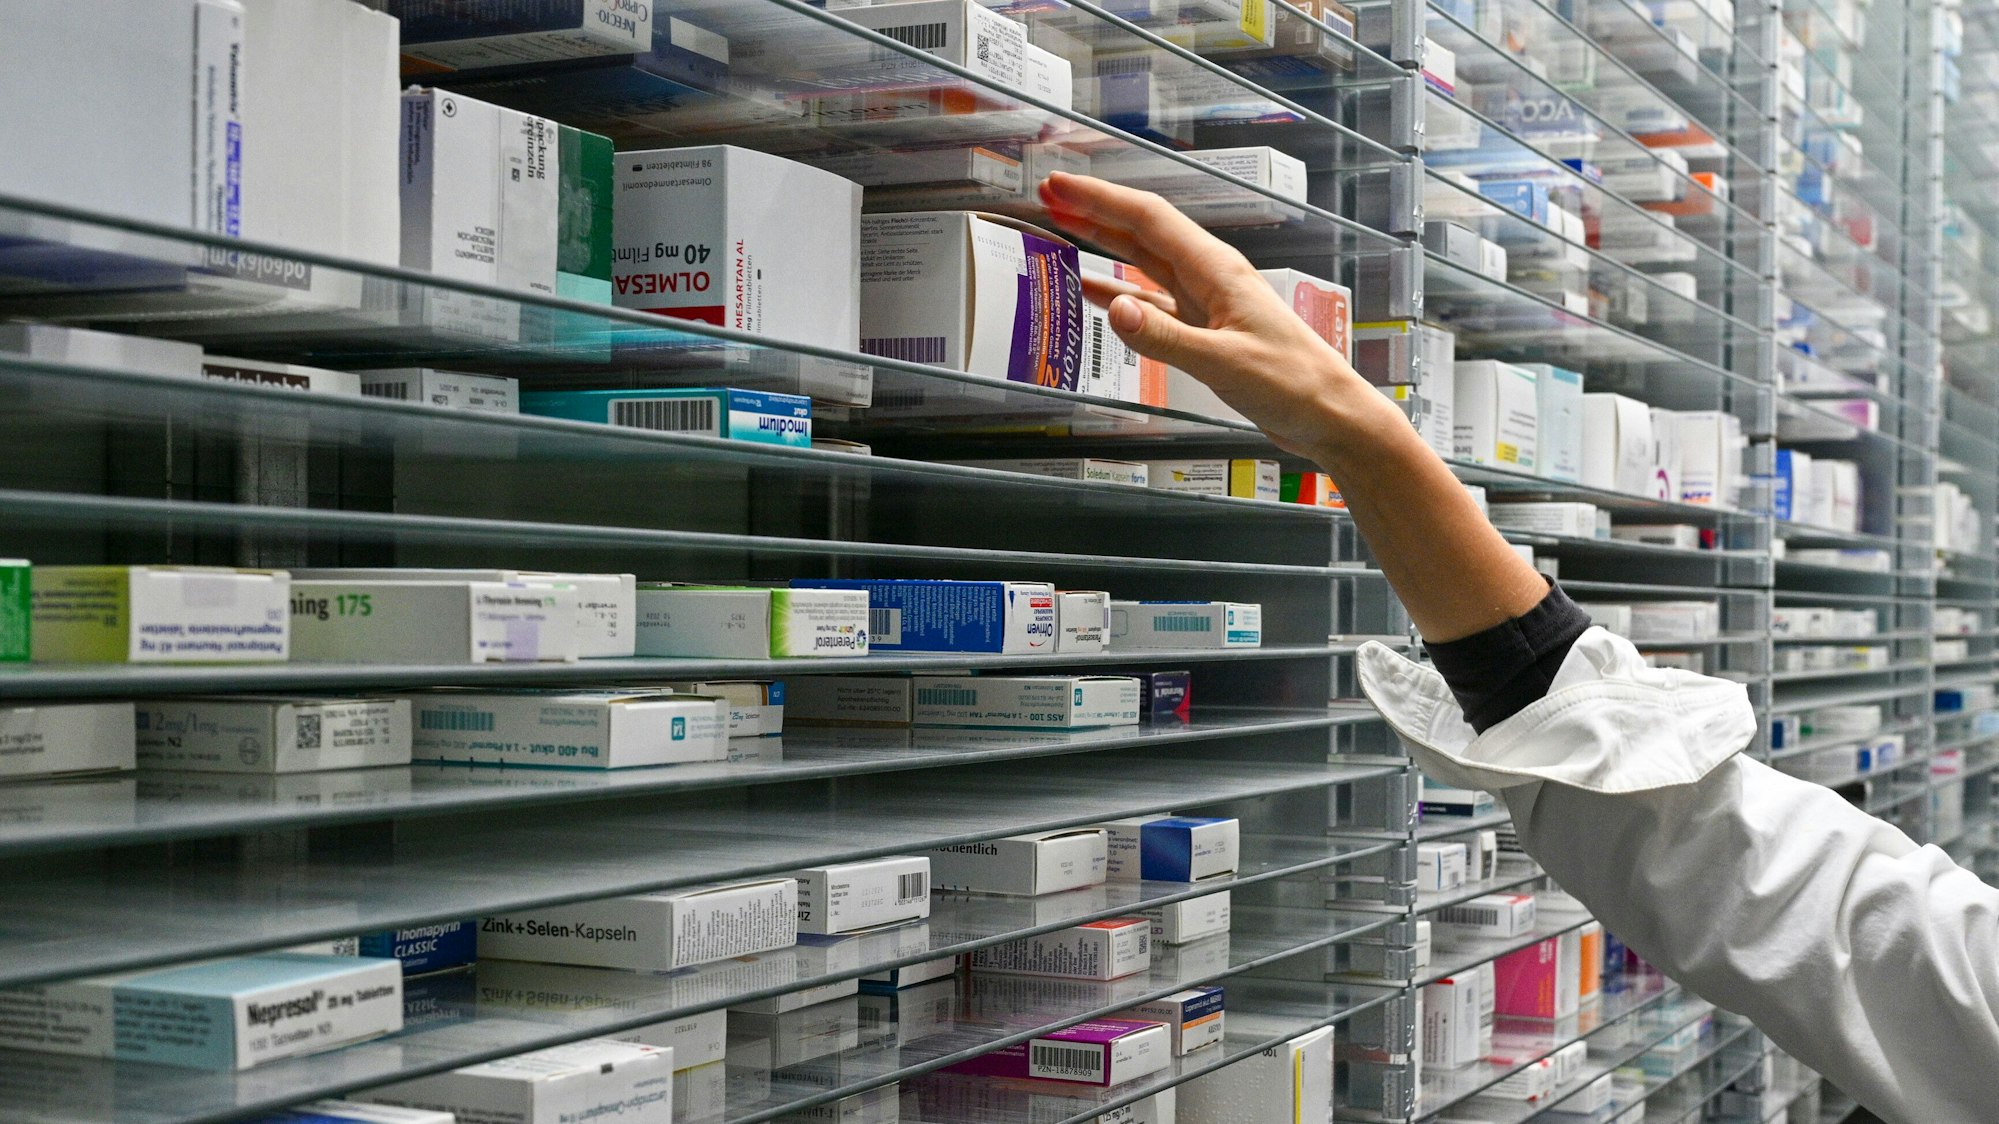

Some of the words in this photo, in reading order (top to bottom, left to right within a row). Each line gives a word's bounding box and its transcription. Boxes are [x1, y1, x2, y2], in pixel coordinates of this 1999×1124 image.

[646, 160, 700, 171] Filmtabletten
[702, 159, 712, 168] 98
[622, 177, 712, 192] Olmesartanmedoxomil
[655, 243, 679, 259] mg
[684, 244, 711, 265] 40
[736, 239, 744, 255] AL
[612, 247, 650, 264] Filmt
[613, 271, 711, 295] OLMESA
[736, 258, 744, 329] MESARTAN
[1050, 251, 1062, 360] Schwangerschaft
[746, 317, 753, 331] mg
[1043, 364, 1061, 389] 2
[794, 407, 808, 418] akut
[759, 416, 808, 437] Imodium
[1087, 467, 1111, 480] Soledum
[1131, 472, 1146, 484] forte
[336, 594, 373, 617] 175
[1027, 623, 1053, 638] Otriven
[814, 636, 856, 650] Perenterol
[1029, 713, 1044, 721] 100
[1046, 713, 1065, 722] ASS
[529, 743, 556, 756] akut
[558, 745, 578, 756] 400
[580, 746, 599, 758] Ibu
[931, 841, 998, 856] chentlich
[482, 917, 637, 943] Zink+Selen-Kapseln
[394, 938, 439, 958] CLASSIC
[247, 994, 319, 1028] Nepresol
[1037, 1065, 1092, 1077] PZN-18878909
